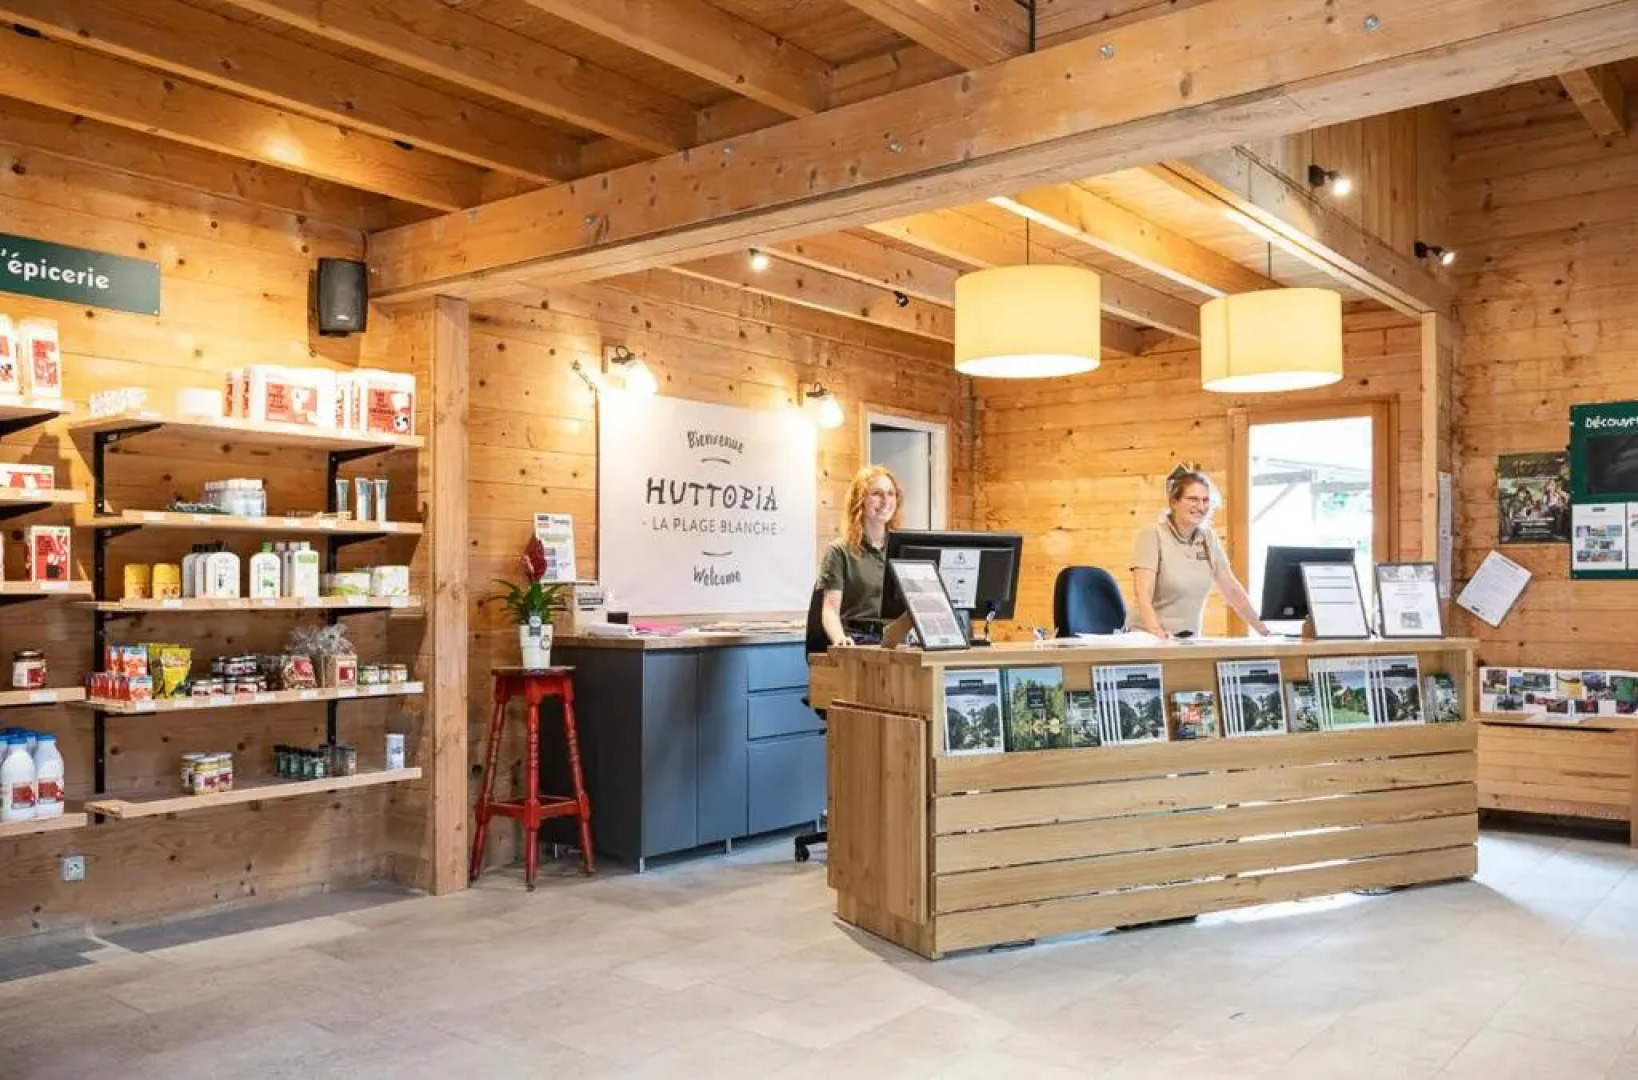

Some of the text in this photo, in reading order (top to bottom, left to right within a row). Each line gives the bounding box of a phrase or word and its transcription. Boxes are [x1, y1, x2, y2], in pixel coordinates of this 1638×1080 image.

[687, 430, 744, 454] Bienvenue
[646, 477, 778, 511] HUTTOPIA
[652, 518, 778, 535] LA PLAGE BLANCHE
[693, 565, 741, 587] Welcome
